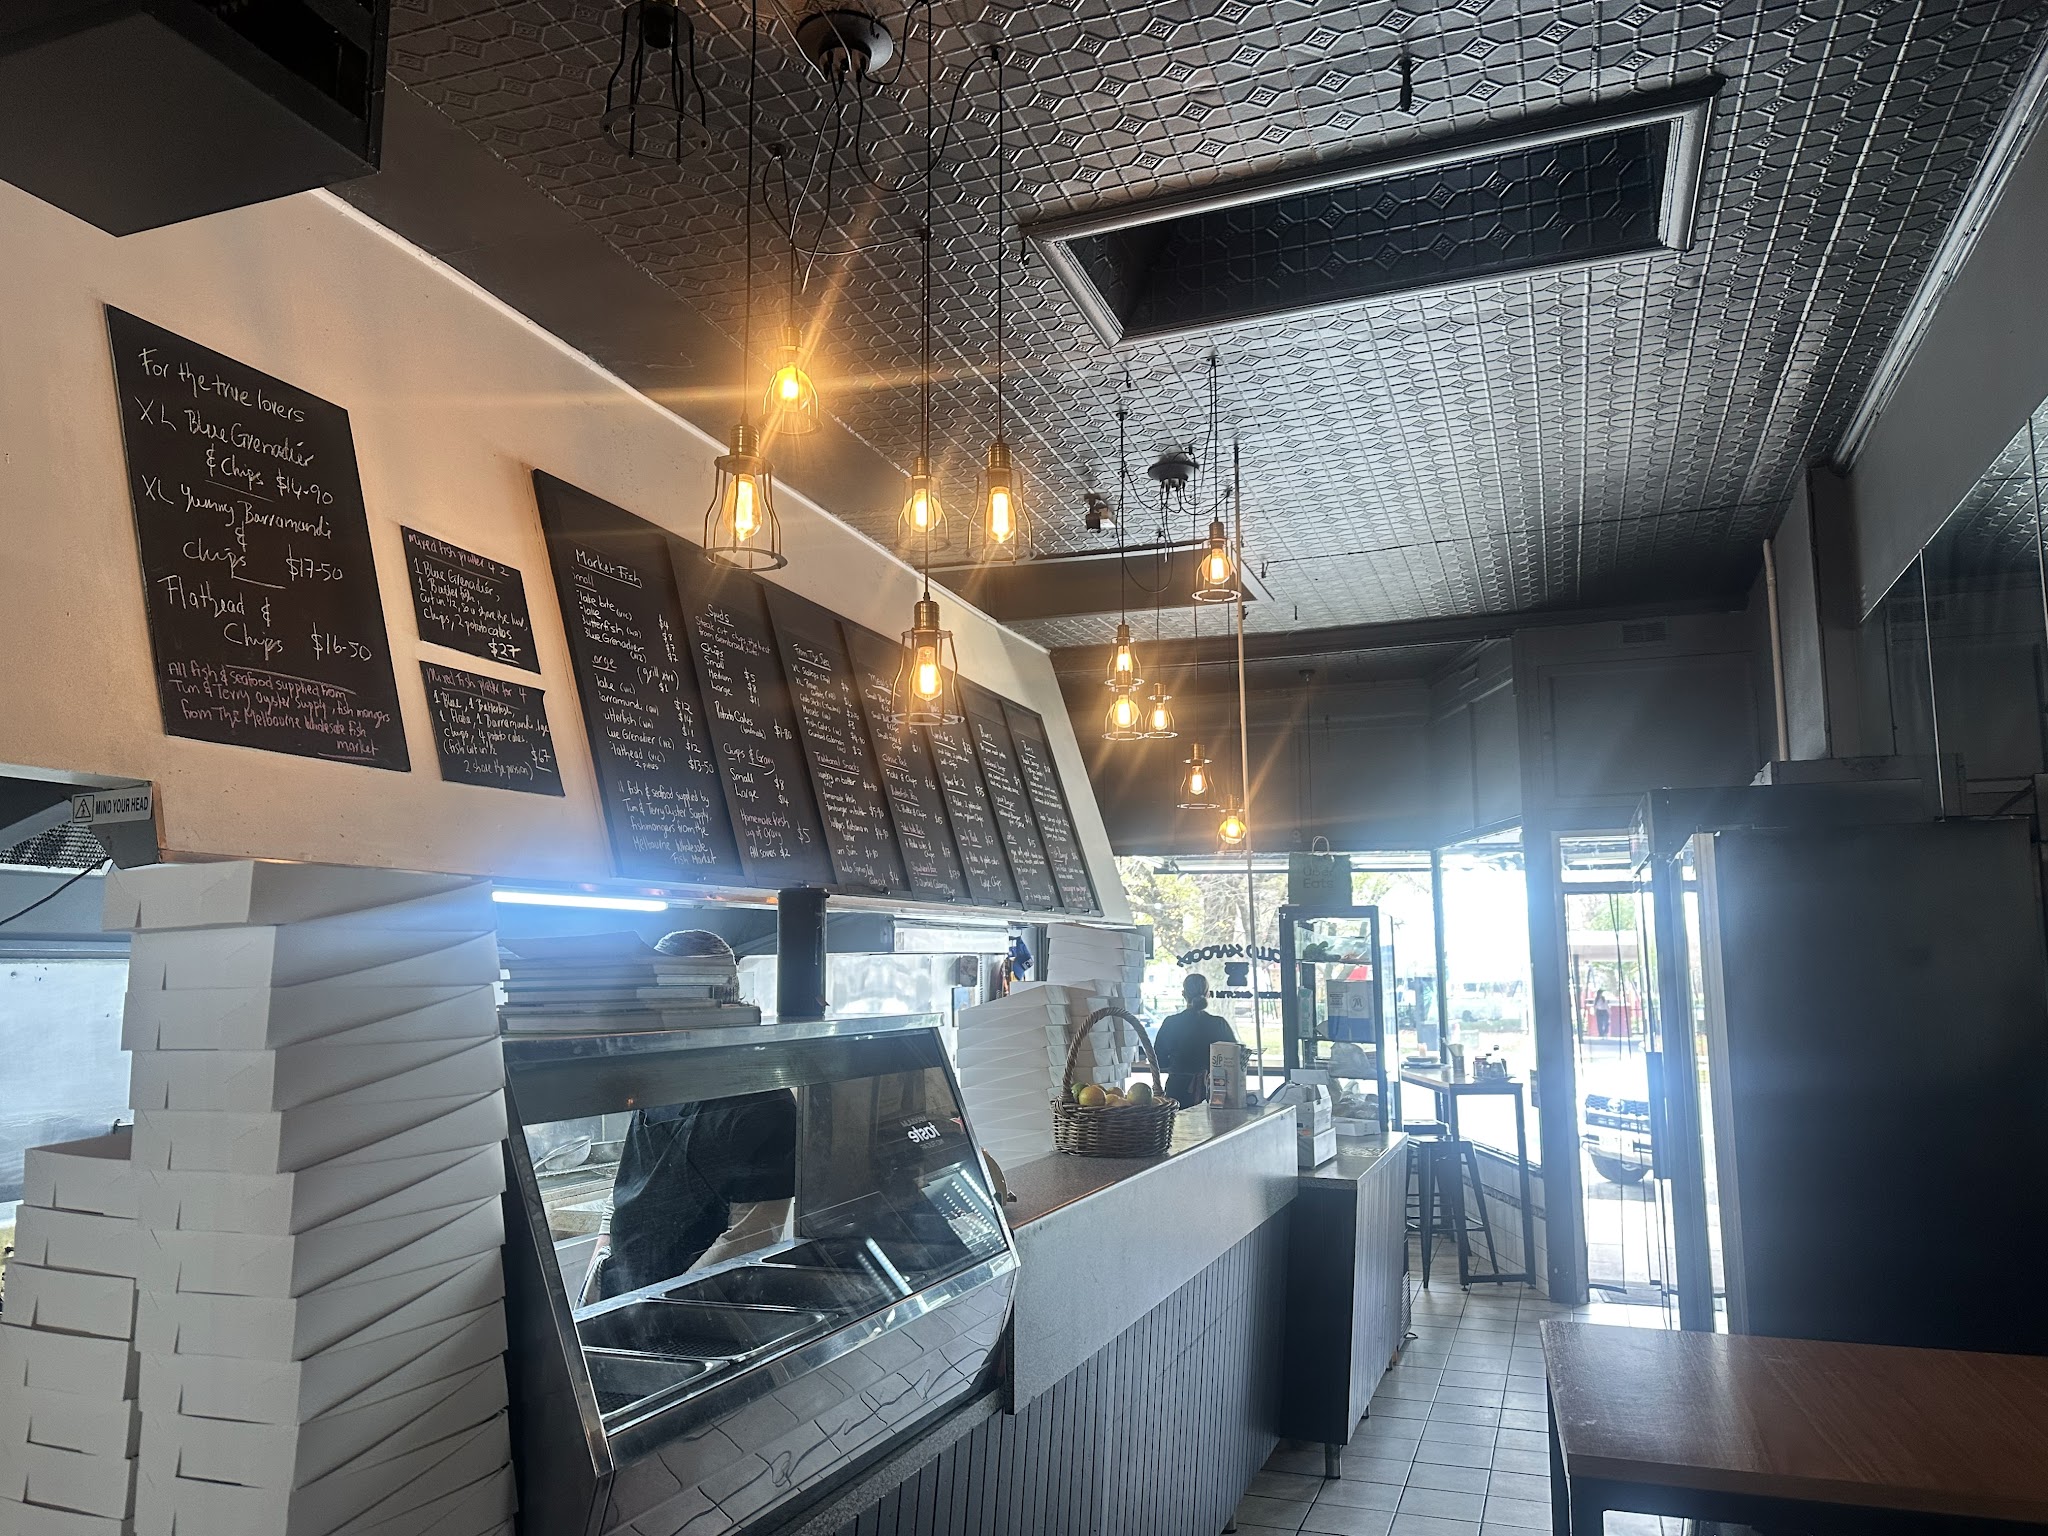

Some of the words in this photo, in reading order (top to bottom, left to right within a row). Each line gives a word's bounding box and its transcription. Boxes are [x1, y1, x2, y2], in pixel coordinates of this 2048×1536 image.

[138, 347, 170, 378] For
[178, 362, 211, 398] the
[212, 374, 253, 407] true
[257, 389, 305, 423] lovers
[184, 408, 229, 444] Blue
[206, 443, 217, 478] &
[221, 454, 264, 491] Chips
[142, 474, 174, 505] XL
[237, 501, 332, 540] Barramundi
[235, 520, 248, 552] &
[413, 557, 423, 575] 1
[422, 560, 447, 583] Blue
[488, 561, 496, 574] 4
[500, 566, 510, 577] 2
[575, 548, 615, 574] Market
[616, 565, 642, 588] Fish
[418, 574, 427, 592] 1
[157, 575, 245, 618] Flathead
[260, 597, 271, 628] &
[454, 613, 465, 628] 2
[705, 603, 730, 624] Spuds
[223, 623, 284, 661] Chips
[488, 638, 521, 658] $27
[703, 655, 725, 670] Small
[168, 661, 188, 678] All
[190, 659, 218, 682] fish
[276, 680, 320, 698] supplied
[710, 680, 733, 697] Large
[168, 679, 200, 694] Tim
[212, 683, 250, 711] Terry
[433, 689, 441, 704] 1
[519, 687, 527, 704] 4
[244, 707, 302, 729] Melbourne
[478, 728, 486, 744] 4
[463, 760, 471, 774] 2
[729, 768, 754, 783] Small
[734, 784, 760, 802] Large
[95, 800, 112, 815] MIND
[113, 798, 130, 813] YOUR
[130, 796, 149, 812] HEAD
[797, 820, 811, 845] $5
[1303, 866, 1333, 877] Uber
[1303, 877, 1334, 889] Eats
